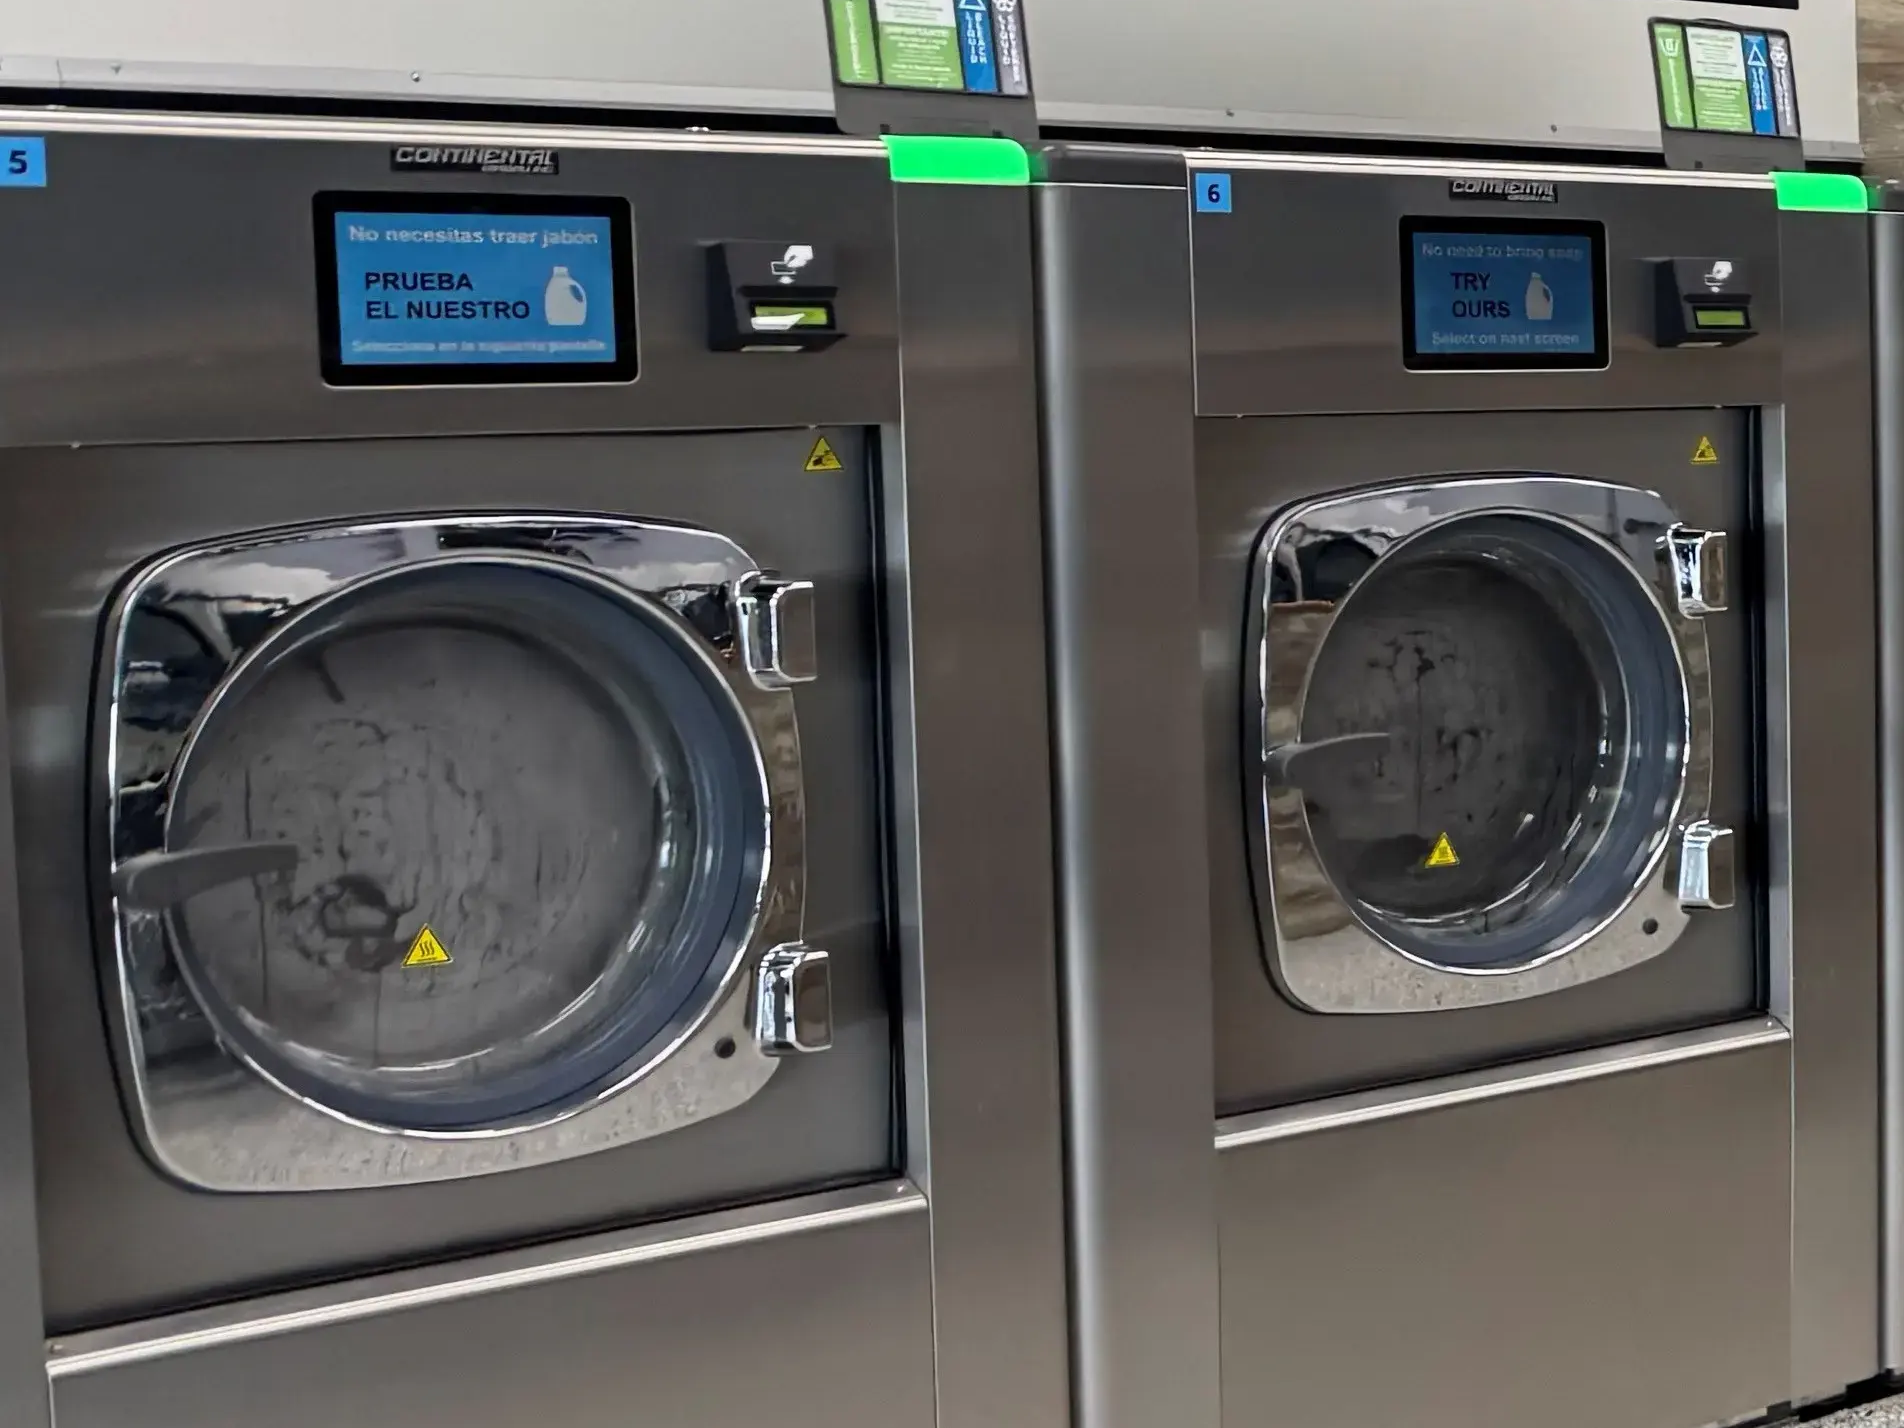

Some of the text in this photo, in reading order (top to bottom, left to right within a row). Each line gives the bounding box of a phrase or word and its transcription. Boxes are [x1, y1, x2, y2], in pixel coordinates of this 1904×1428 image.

[8, 149, 28, 175] 5
[395, 146, 553, 165] CONTINENTAL
[1206, 183, 1221, 205] 6
[348, 224, 379, 242] No
[385, 227, 484, 244] necesitas
[490, 228, 536, 244] traer
[1422, 243, 1443, 256] No
[364, 271, 474, 292] PRUEBA
[1451, 271, 1492, 292] TRY
[366, 299, 531, 320] EL NUESTRO
[1452, 300, 1511, 319] OURS
[1432, 331, 1476, 345] Select
[1479, 333, 1496, 345] on
